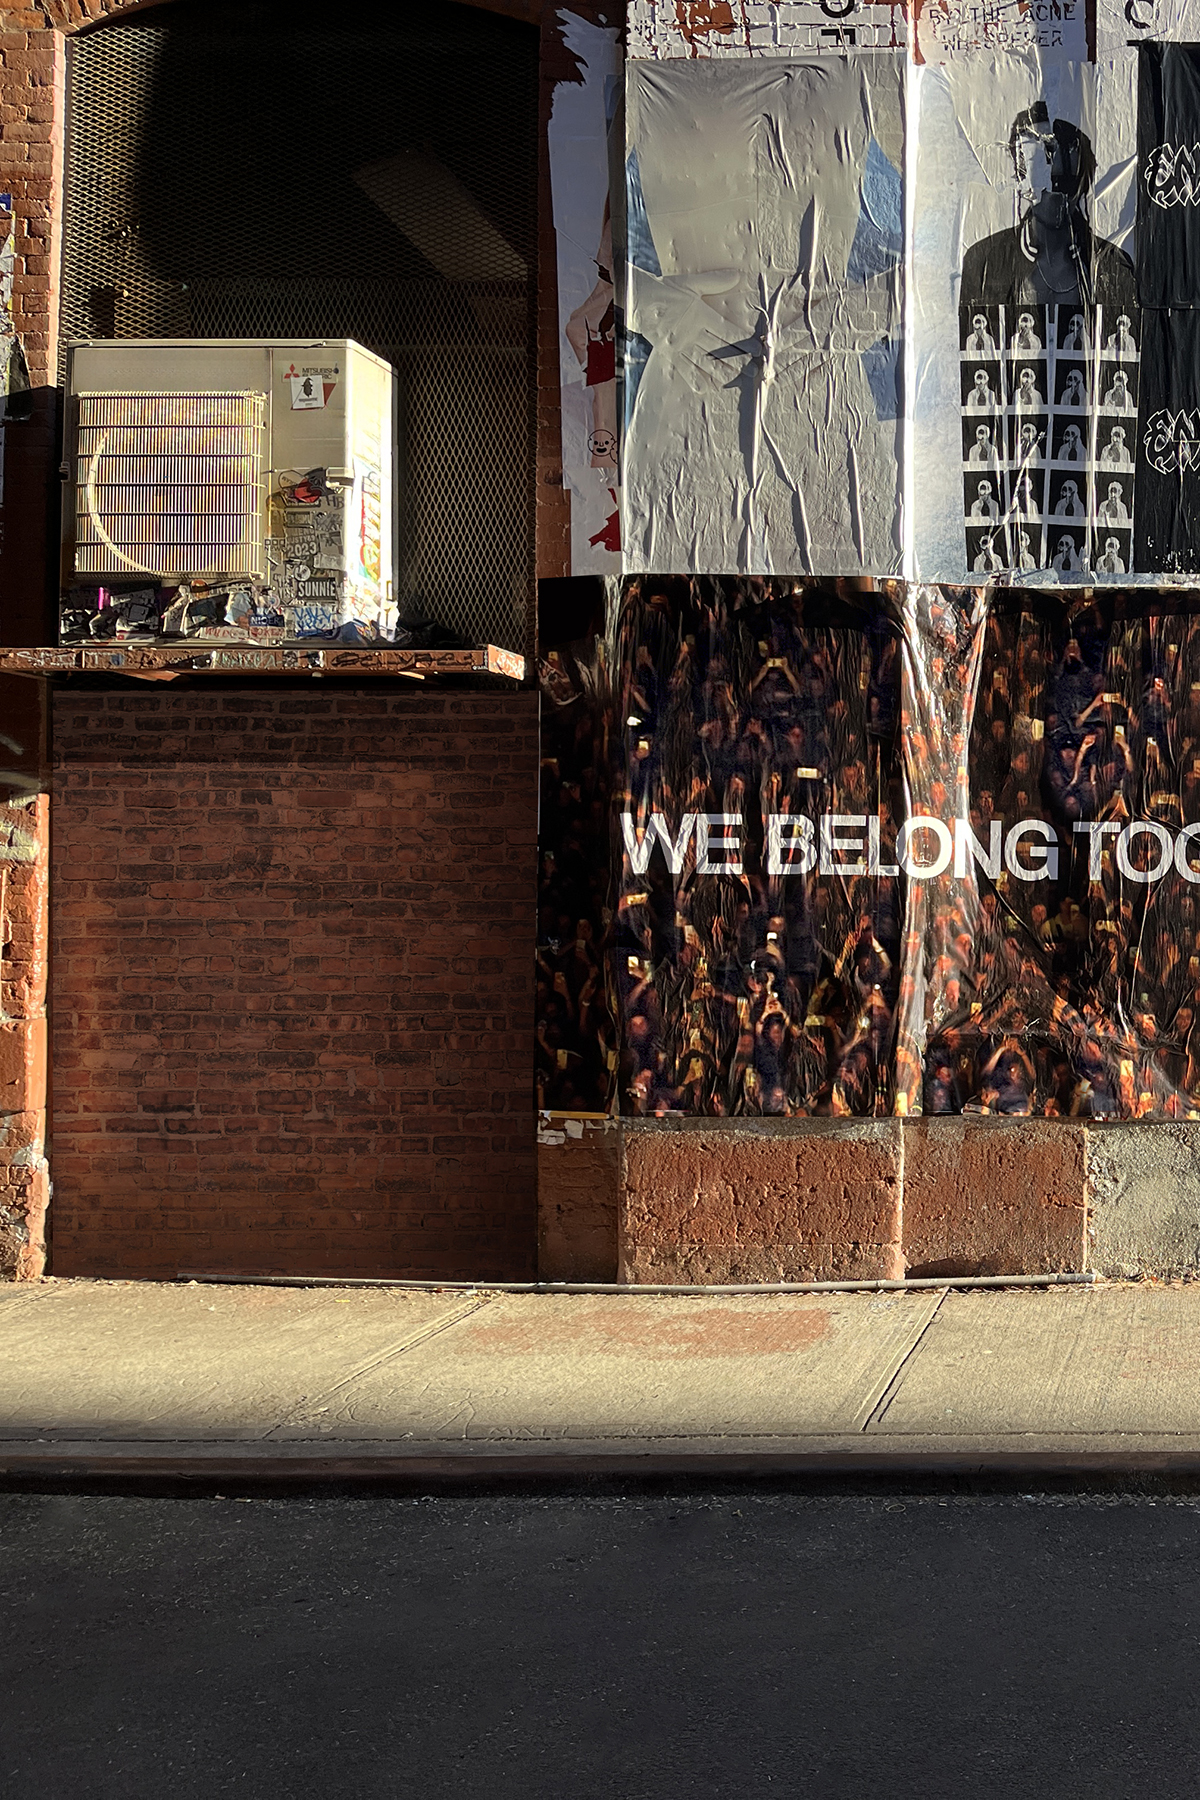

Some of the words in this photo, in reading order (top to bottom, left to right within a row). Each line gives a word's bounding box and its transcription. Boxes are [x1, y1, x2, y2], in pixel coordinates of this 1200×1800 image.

[969, 6, 1007, 22] THE
[298, 581, 336, 597] SUNNIE
[619, 812, 743, 875] WE
[767, 813, 1059, 881] BELONG
